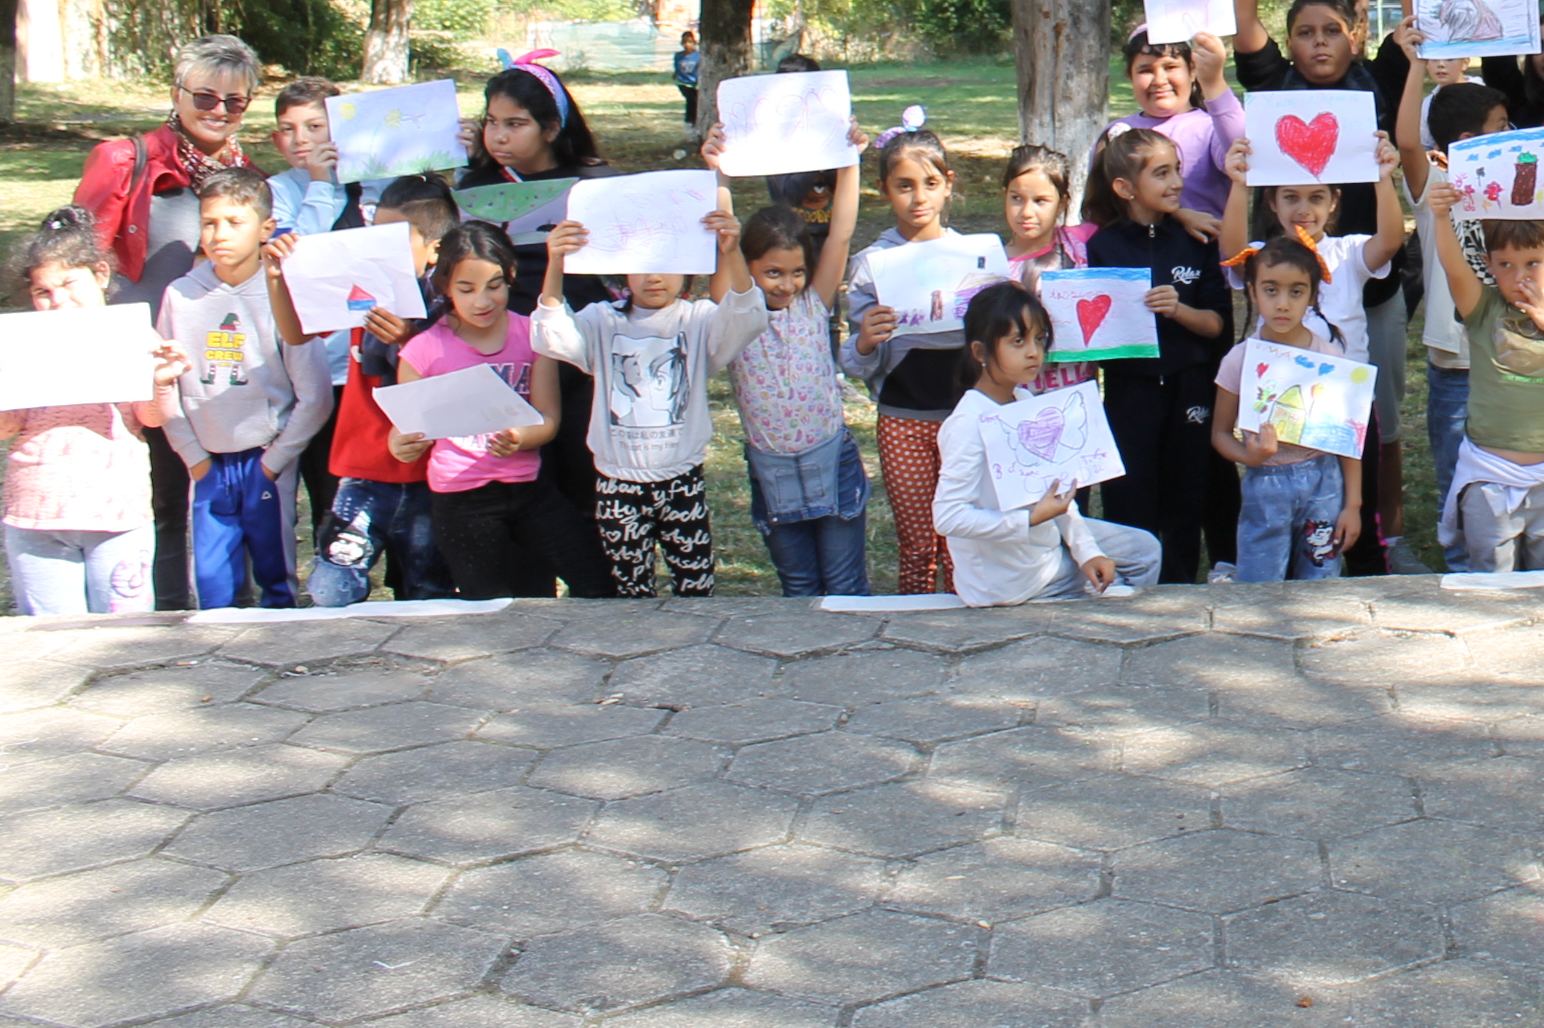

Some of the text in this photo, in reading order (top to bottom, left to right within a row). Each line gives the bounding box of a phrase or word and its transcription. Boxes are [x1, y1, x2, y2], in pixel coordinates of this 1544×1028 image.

[1171, 266, 1202, 284] Relax
[206, 331, 247, 349] ELF
[205, 350, 245, 362] CREW
